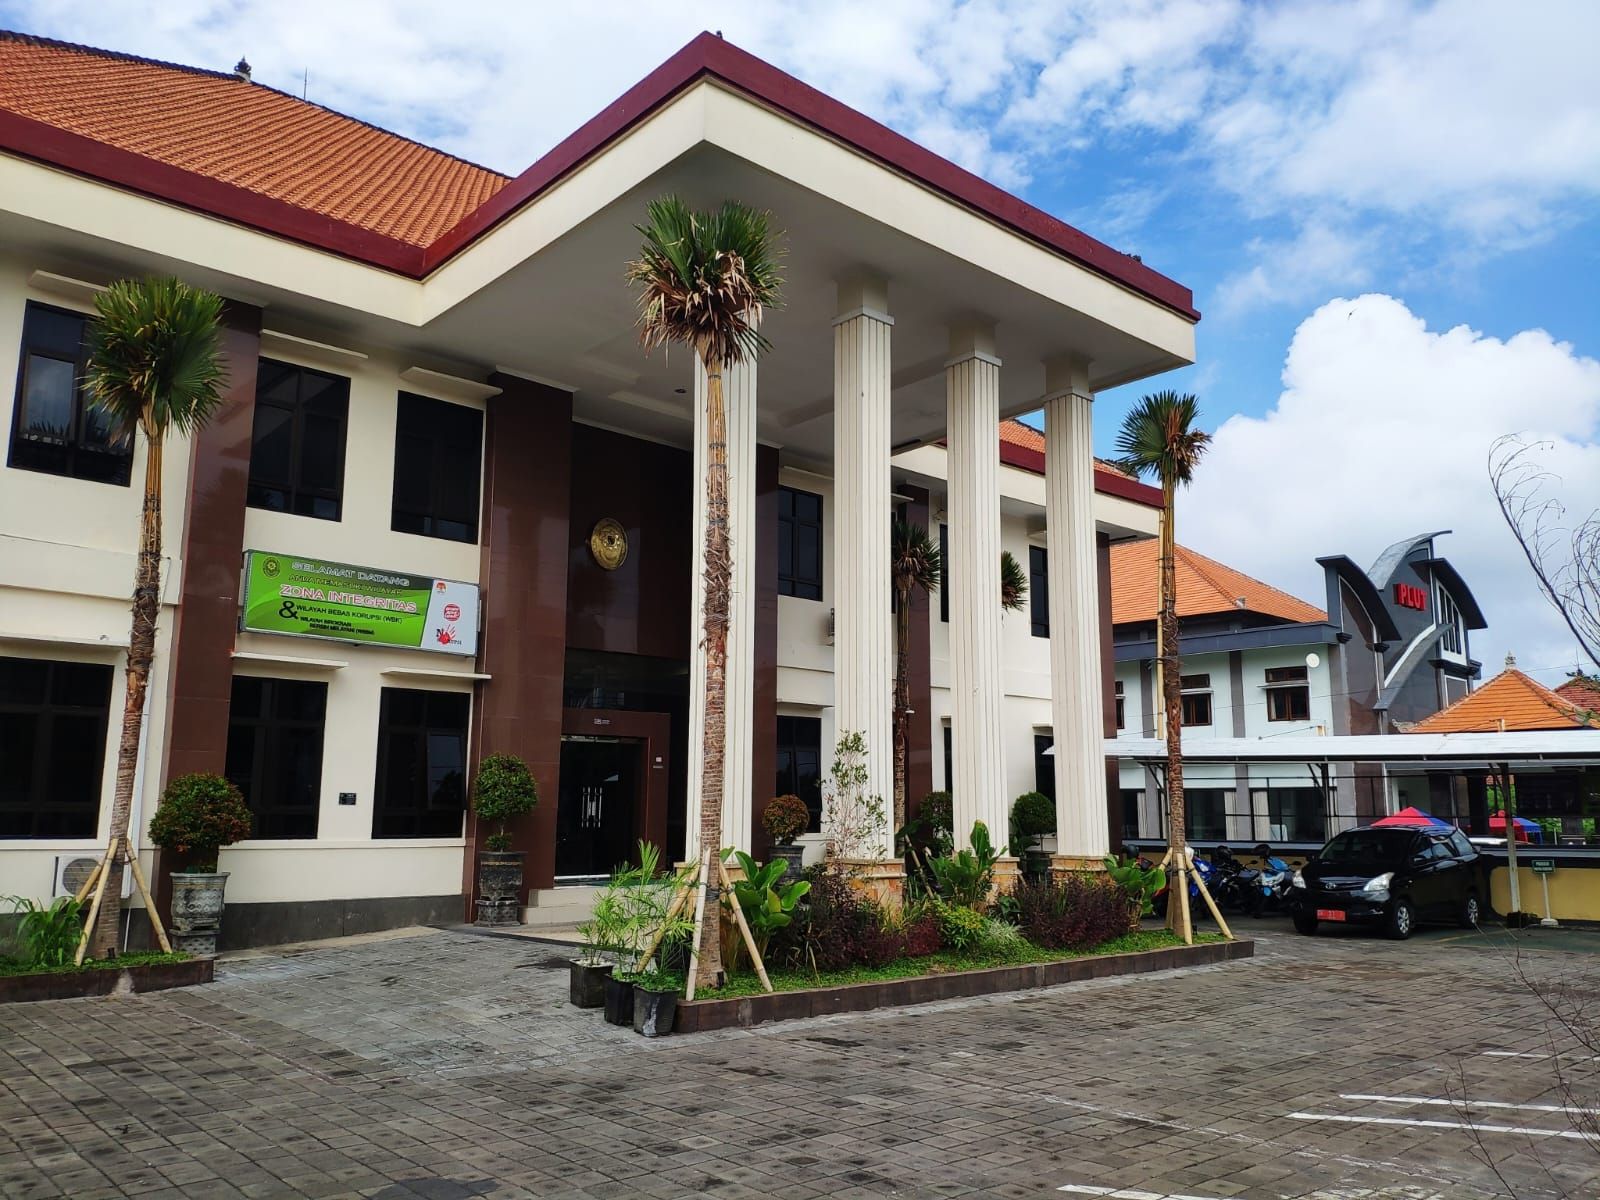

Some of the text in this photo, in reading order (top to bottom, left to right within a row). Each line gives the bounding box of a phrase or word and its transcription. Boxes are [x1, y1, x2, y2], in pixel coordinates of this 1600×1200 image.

[292, 561, 410, 587] SELAMAT DATANG
[279, 584, 417, 613] ZONA INTEGRITAS
[1400, 583, 1427, 610] PLUT
[279, 600, 299, 620] &
[296, 604, 327, 614] WILAYAH
[328, 608, 351, 617] BEBAS
[352, 611, 382, 621] KORUPSI
